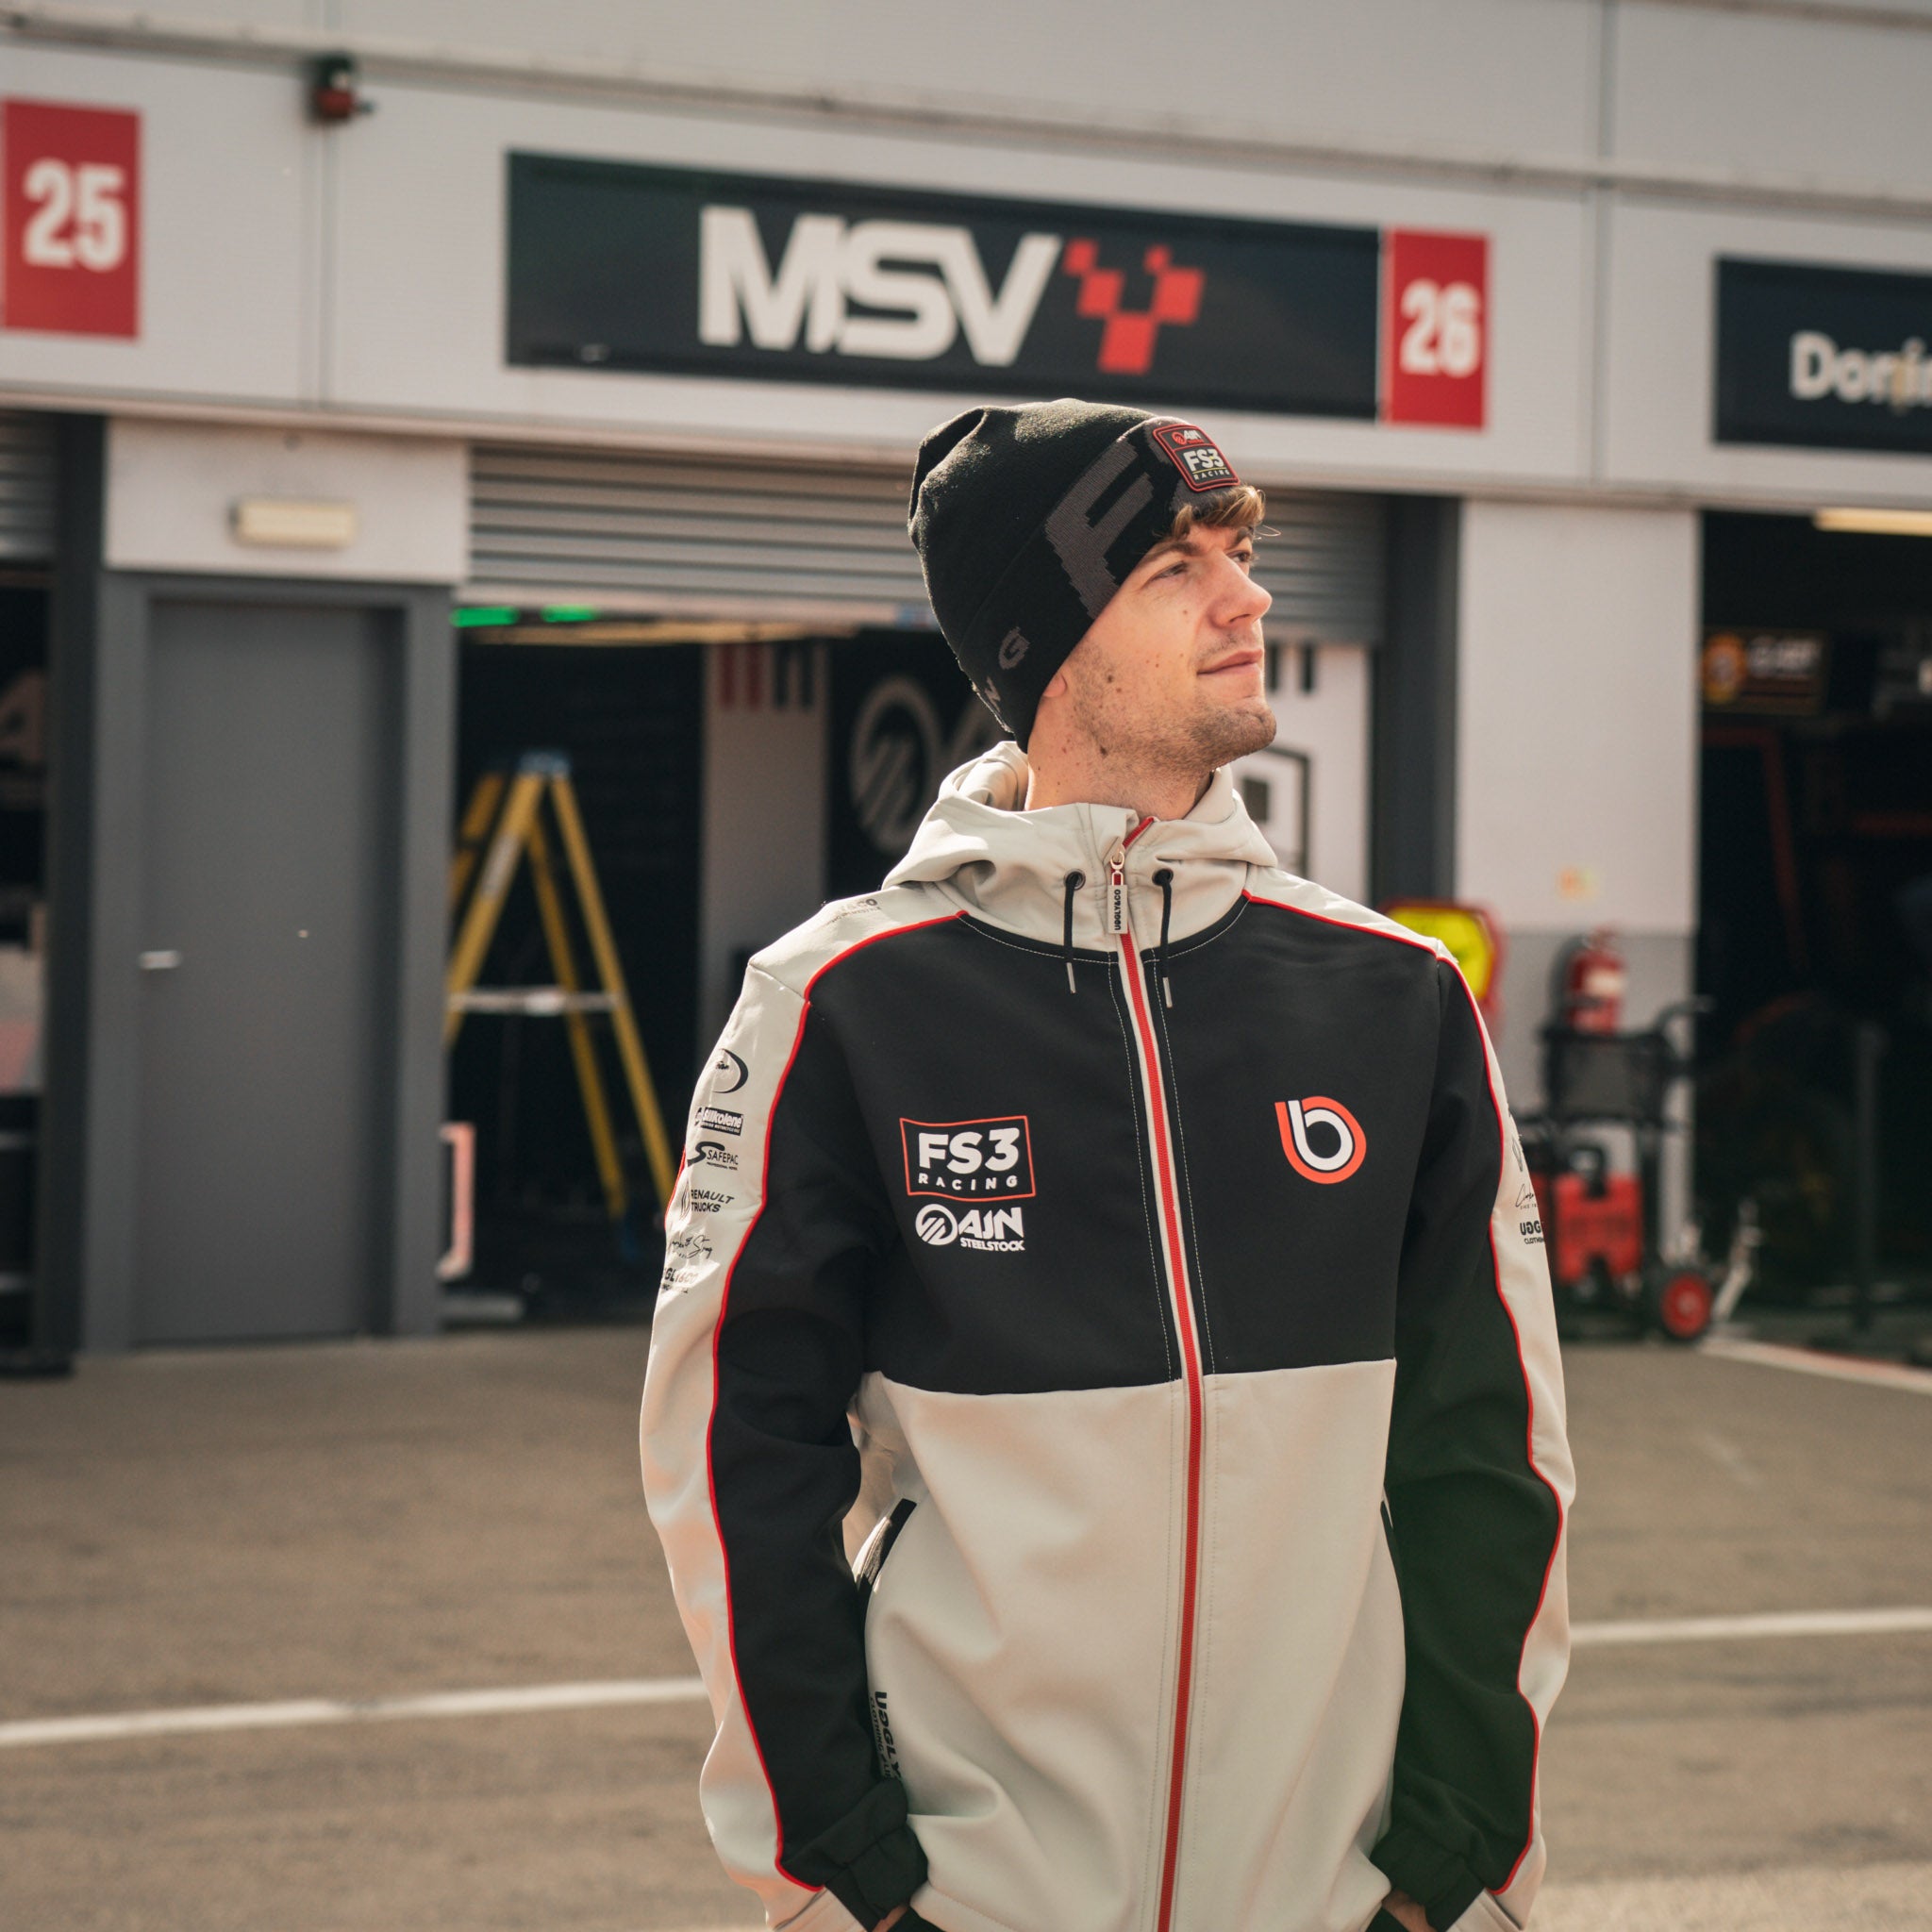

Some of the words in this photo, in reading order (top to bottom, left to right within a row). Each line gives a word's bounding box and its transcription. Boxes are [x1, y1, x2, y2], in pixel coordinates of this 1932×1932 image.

[23, 157, 127, 274] 25
[698, 205, 1061, 366] MSV
[1400, 277, 1482, 379] 26
[1790, 330, 1932, 407] Doni
[1183, 448, 1224, 472] FS3
[707, 1149, 739, 1165] SAFEPAC
[918, 1127, 1021, 1174] FS3
[918, 1173, 1019, 1191] RACING
[691, 1202, 722, 1213] TRUCKS
[958, 1207, 1025, 1241] AJN
[959, 1237, 1026, 1252] STEELSTOCK
